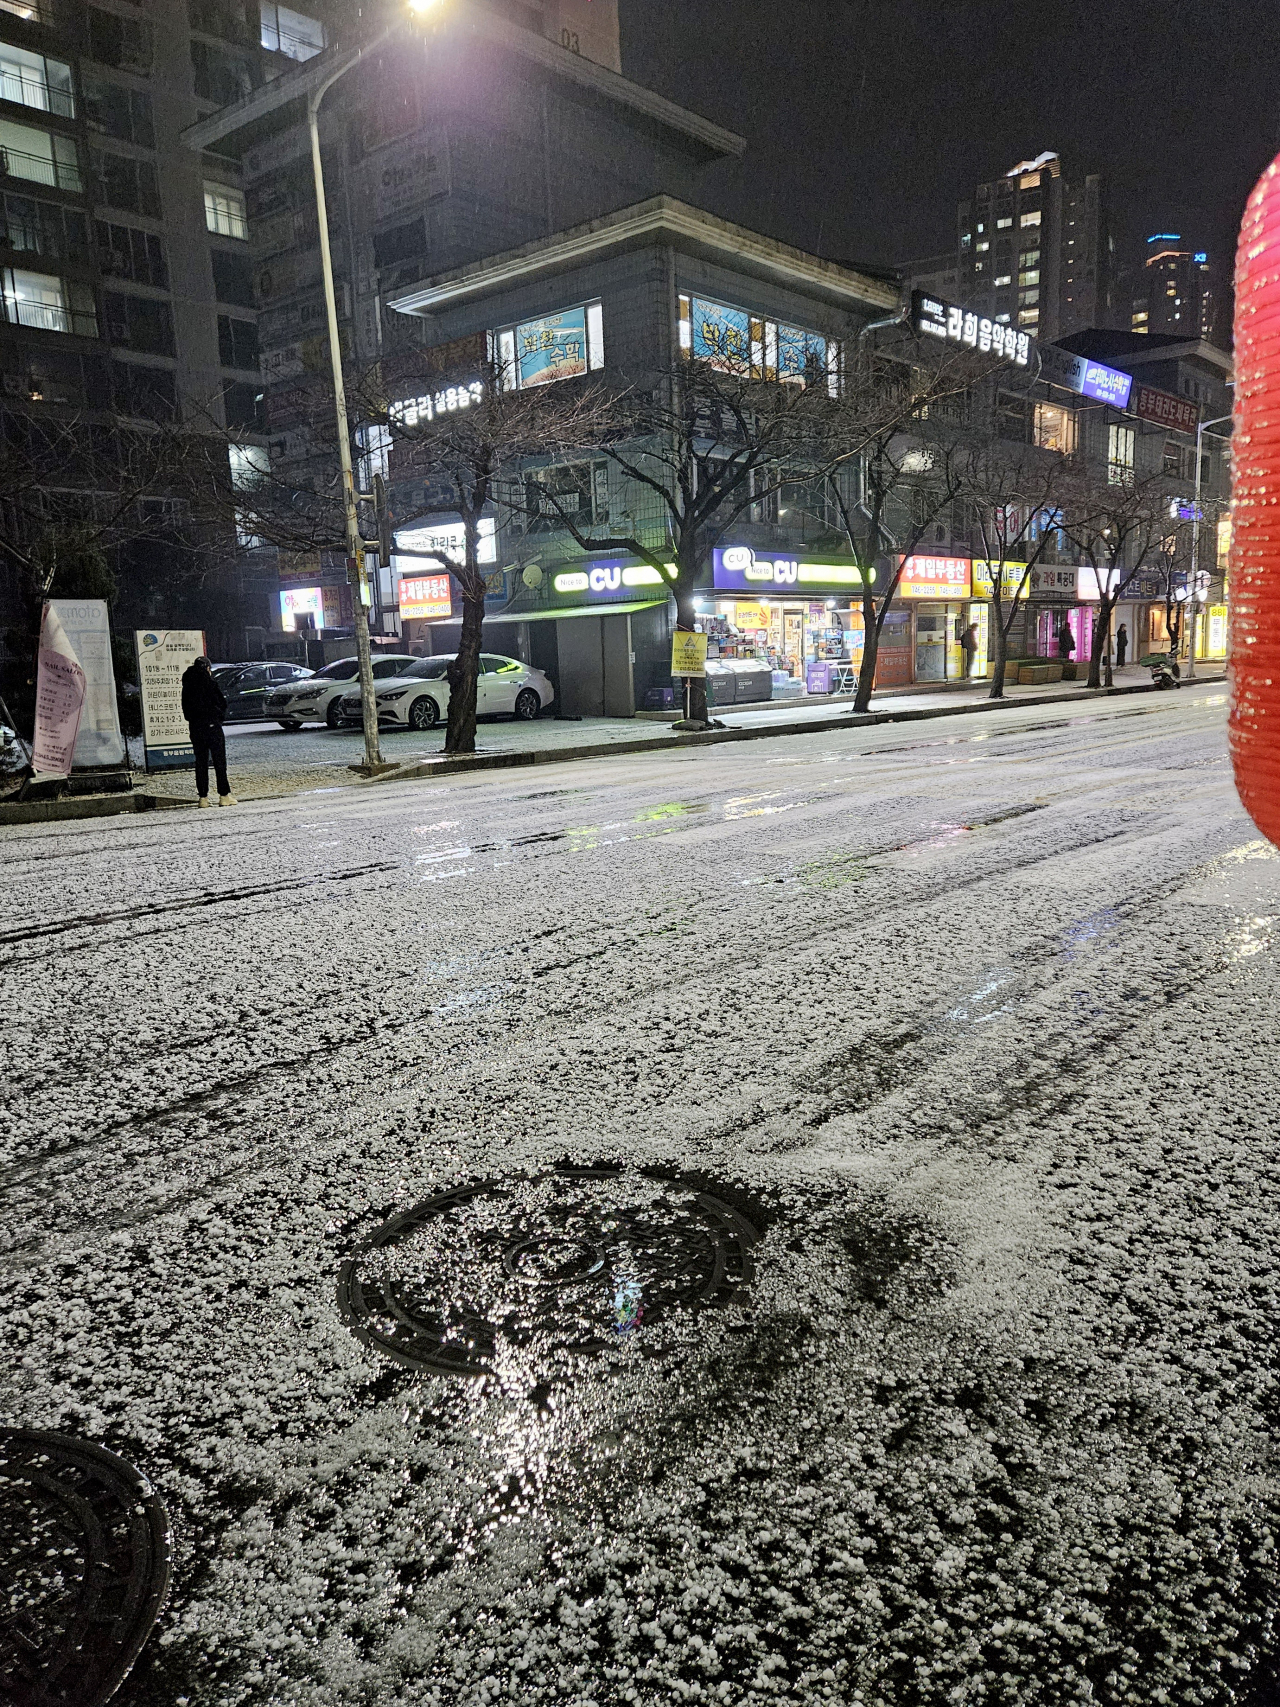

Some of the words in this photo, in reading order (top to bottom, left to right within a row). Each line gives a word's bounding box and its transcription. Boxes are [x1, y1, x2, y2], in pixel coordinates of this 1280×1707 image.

[948, 306, 1029, 365] 라희음악학원
[550, 341, 581, 368] 수학
[1139, 389, 1197, 427] 동부태권도체육관
[728, 553, 744, 563] CU
[750, 565, 763, 575] Nice
[763, 566, 770, 575] to
[773, 559, 798, 583] CU
[916, 558, 966, 579] 제일부동산
[407, 578, 448, 600] 제일부동산
[560, 578, 575, 587] Nice
[576, 577, 583, 586] to
[589, 567, 621, 592] CU
[1043, 571, 1056, 586] 과일
[1057, 571, 1075, 588] 특공대
[44, 661, 60, 671] NAIL
[61, 666, 83, 676] SALON
[166, 664, 180, 672] 111동
[147, 690, 178, 698] 어린이놀이터
[148, 703, 174, 711] 테니스코트
[149, 715, 165, 723] 휴게소
